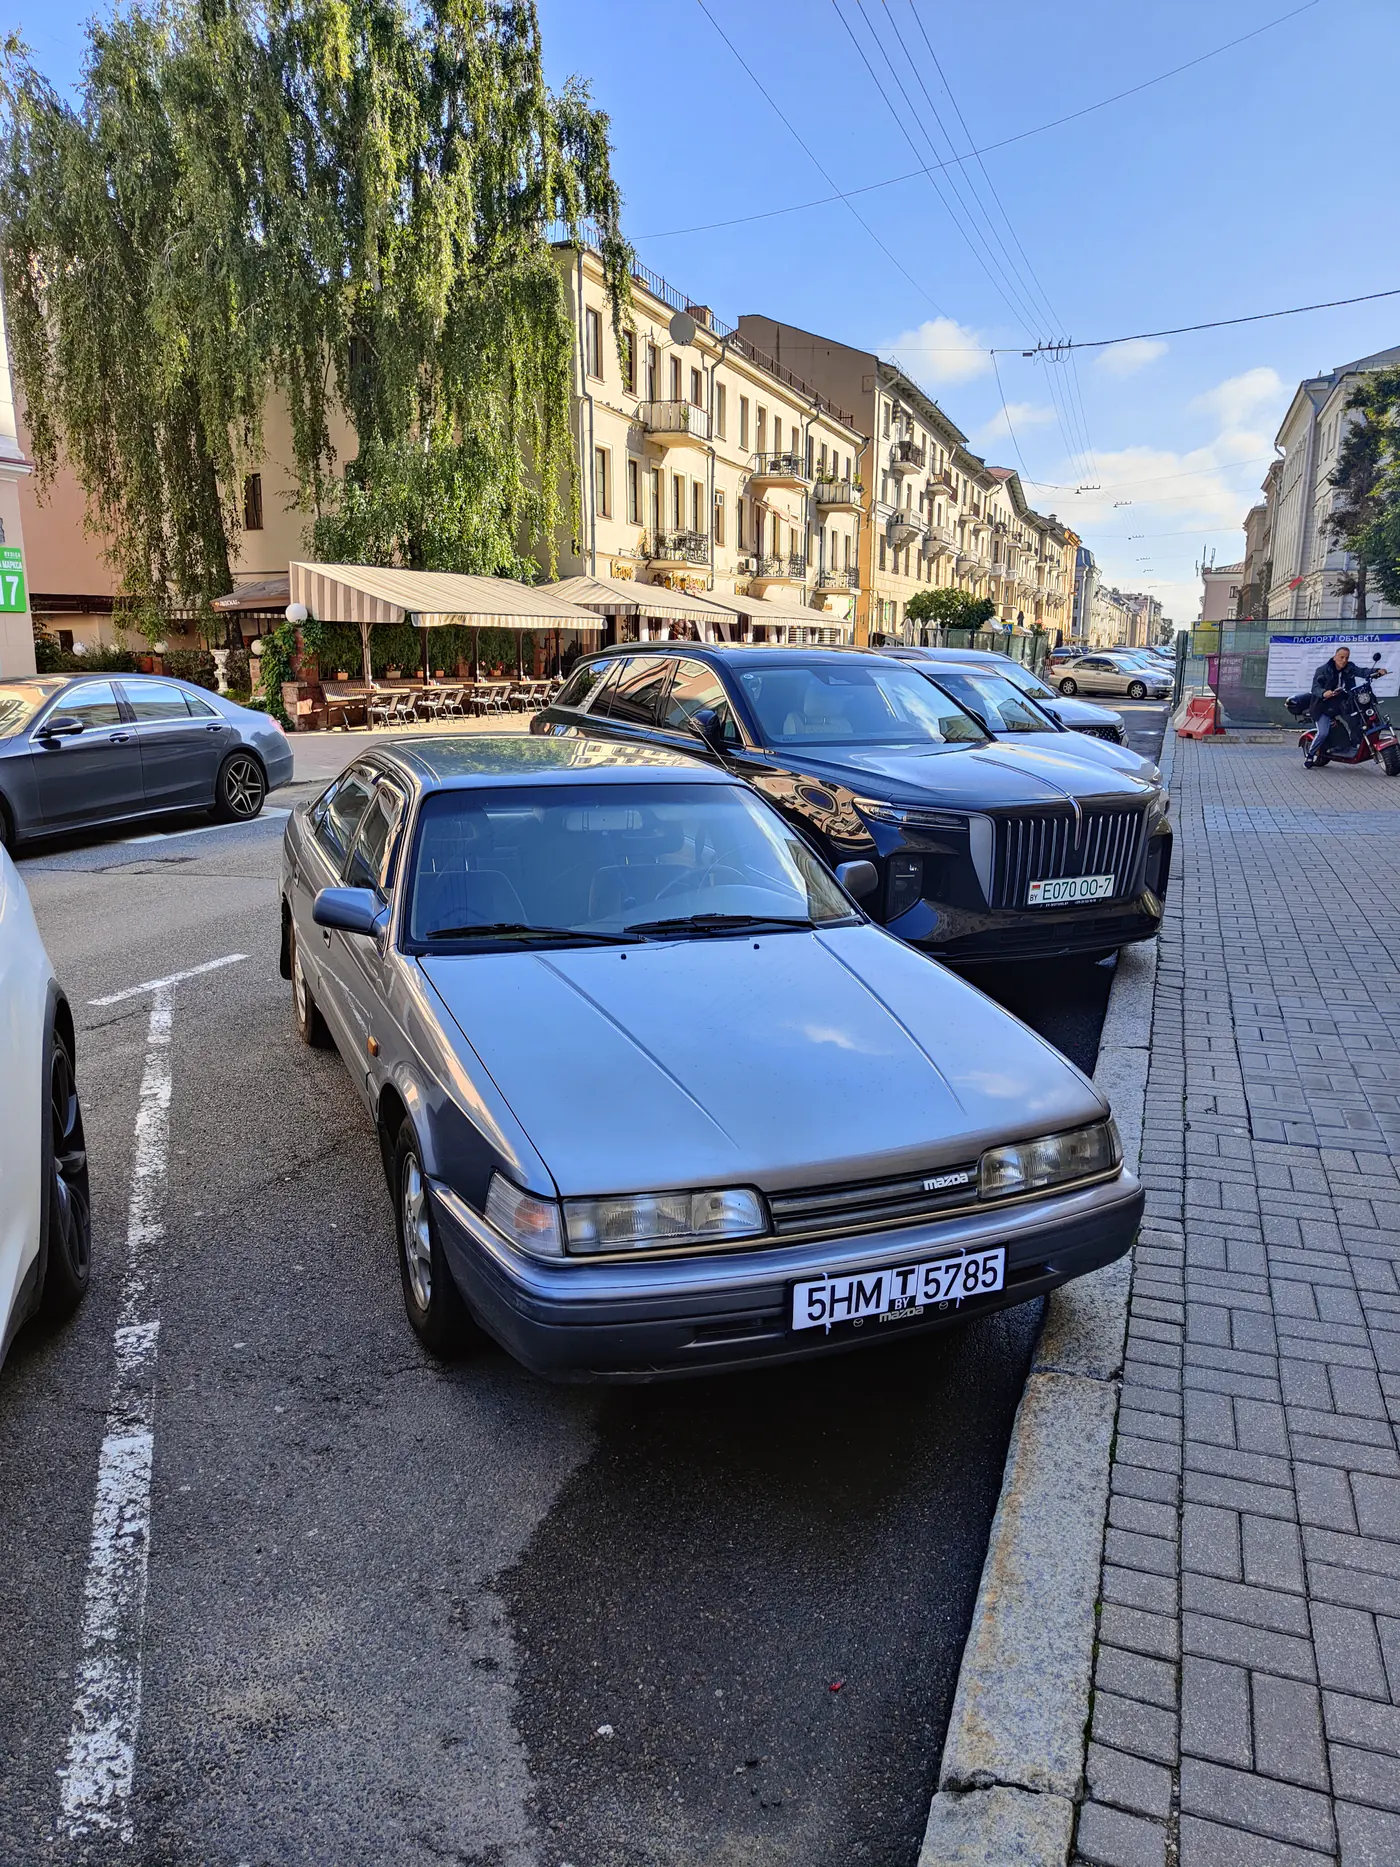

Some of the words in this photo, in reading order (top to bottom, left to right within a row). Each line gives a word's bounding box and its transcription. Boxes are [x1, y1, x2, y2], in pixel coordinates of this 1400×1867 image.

[1338, 634, 1380, 642] ОБЪЕКТА
[1042, 881, 1077, 900] E070
[923, 1172, 969, 1191] mazda
[894, 1297, 911, 1310] BY
[879, 1304, 924, 1323] mazda
